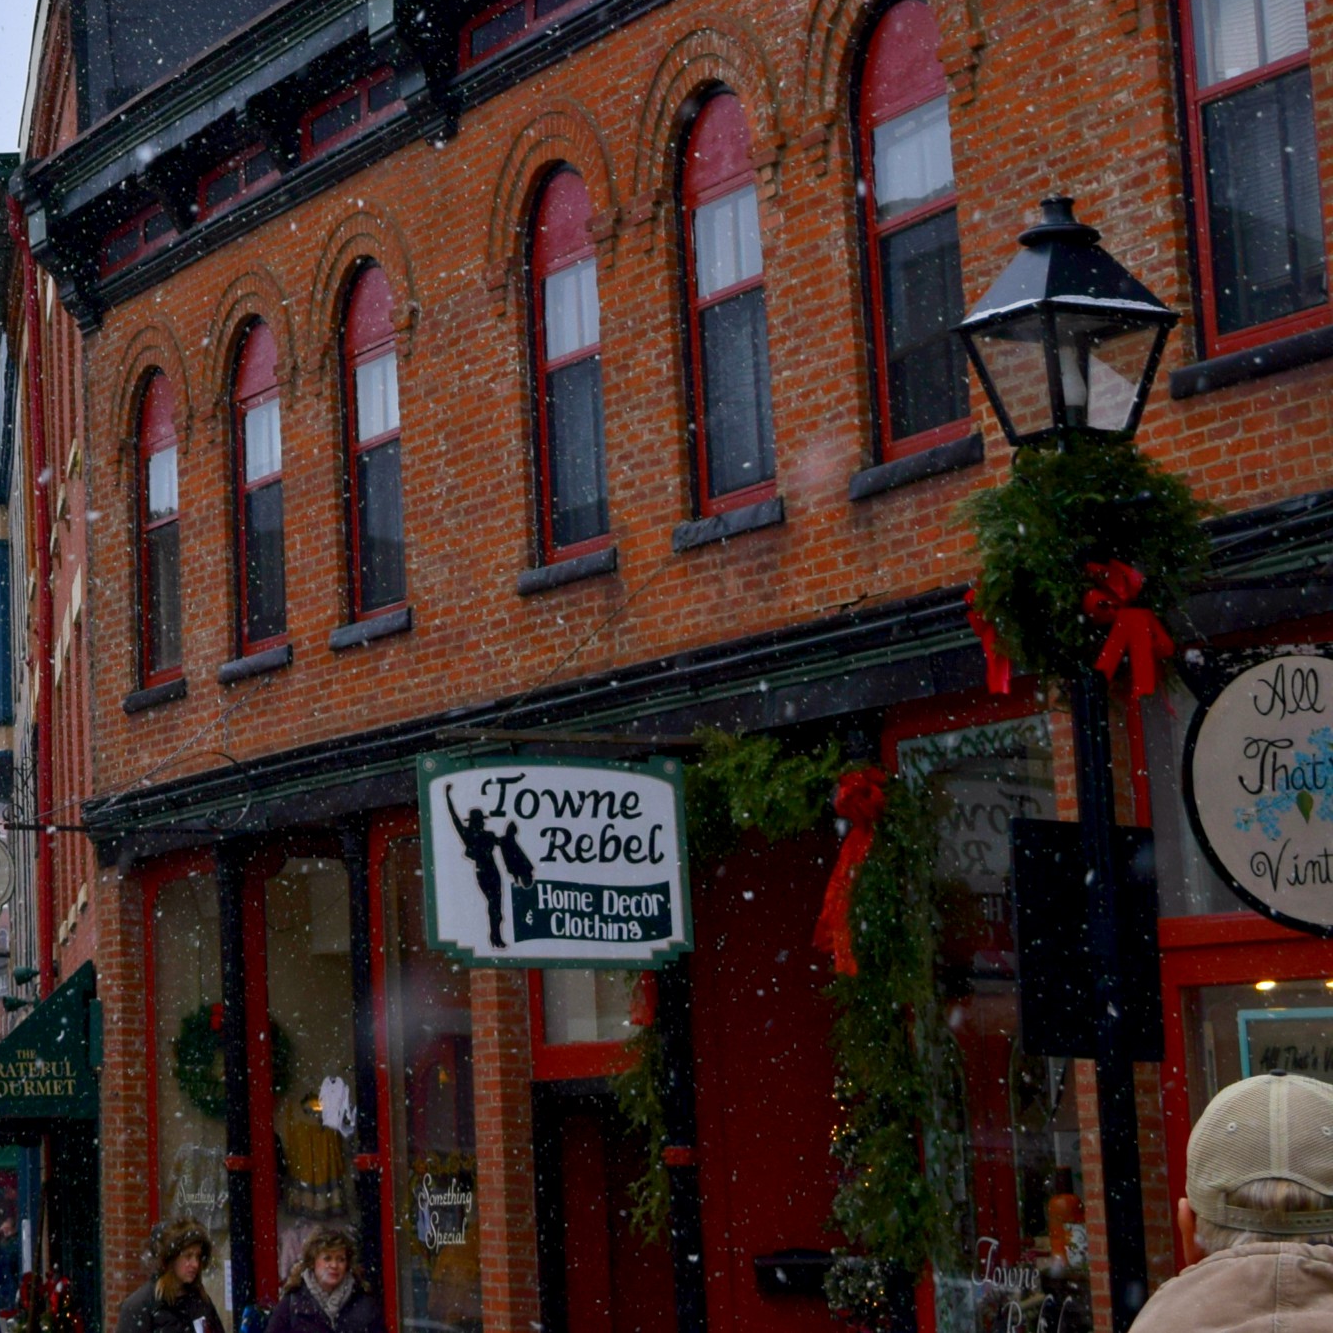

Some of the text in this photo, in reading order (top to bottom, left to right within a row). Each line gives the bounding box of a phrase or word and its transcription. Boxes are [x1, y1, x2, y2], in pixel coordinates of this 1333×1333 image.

[1253, 663, 1327, 720] All
[480, 771, 644, 821] Towne
[538, 822, 666, 865] Rebel
[536, 883, 593, 912] Home
[550, 911, 643, 941] Clothing
[15, 1049, 37, 1059] THE
[418, 1173, 472, 1214] Something
[425, 1210, 468, 1255] Special
[971, 1236, 1040, 1289] Towne
